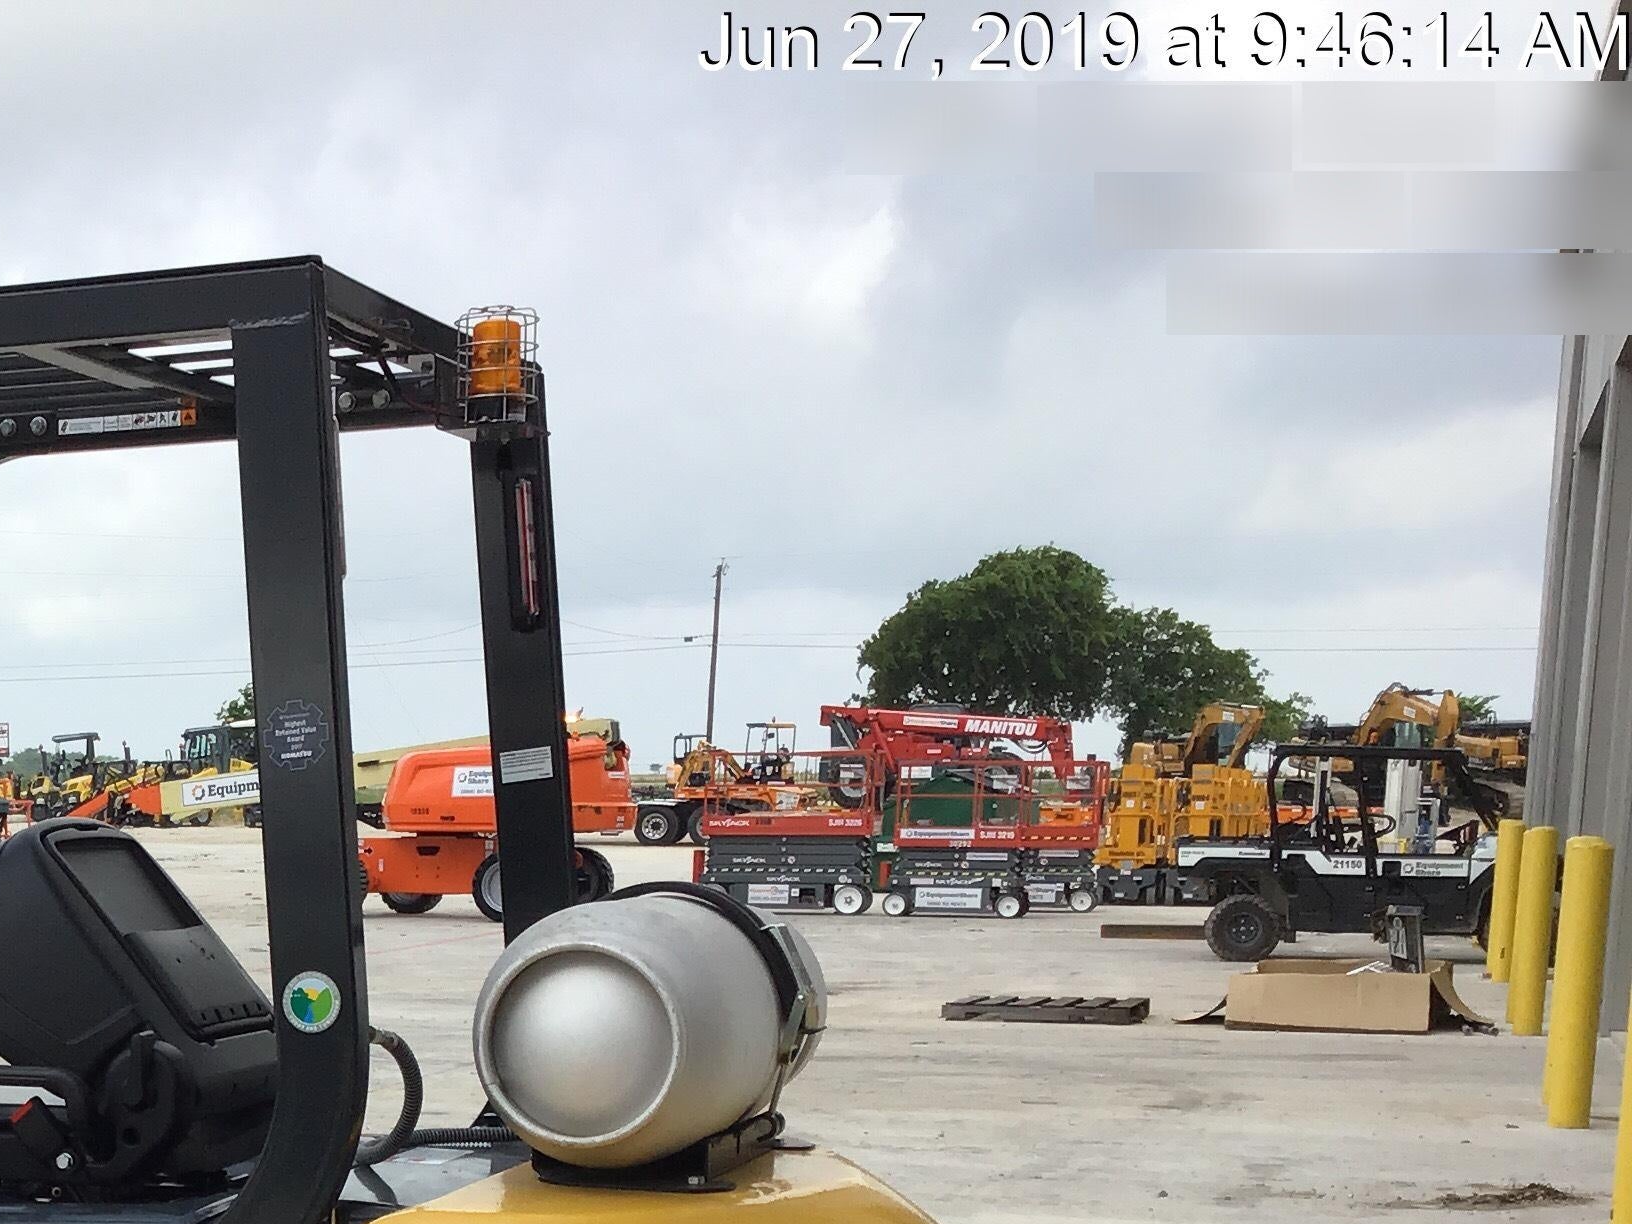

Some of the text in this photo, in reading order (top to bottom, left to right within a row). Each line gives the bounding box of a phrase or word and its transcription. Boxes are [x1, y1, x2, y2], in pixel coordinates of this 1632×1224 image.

[964, 719, 1038, 737] MANITOU
[208, 781, 260, 798] Equipm
[1332, 859, 1363, 870] 21150
